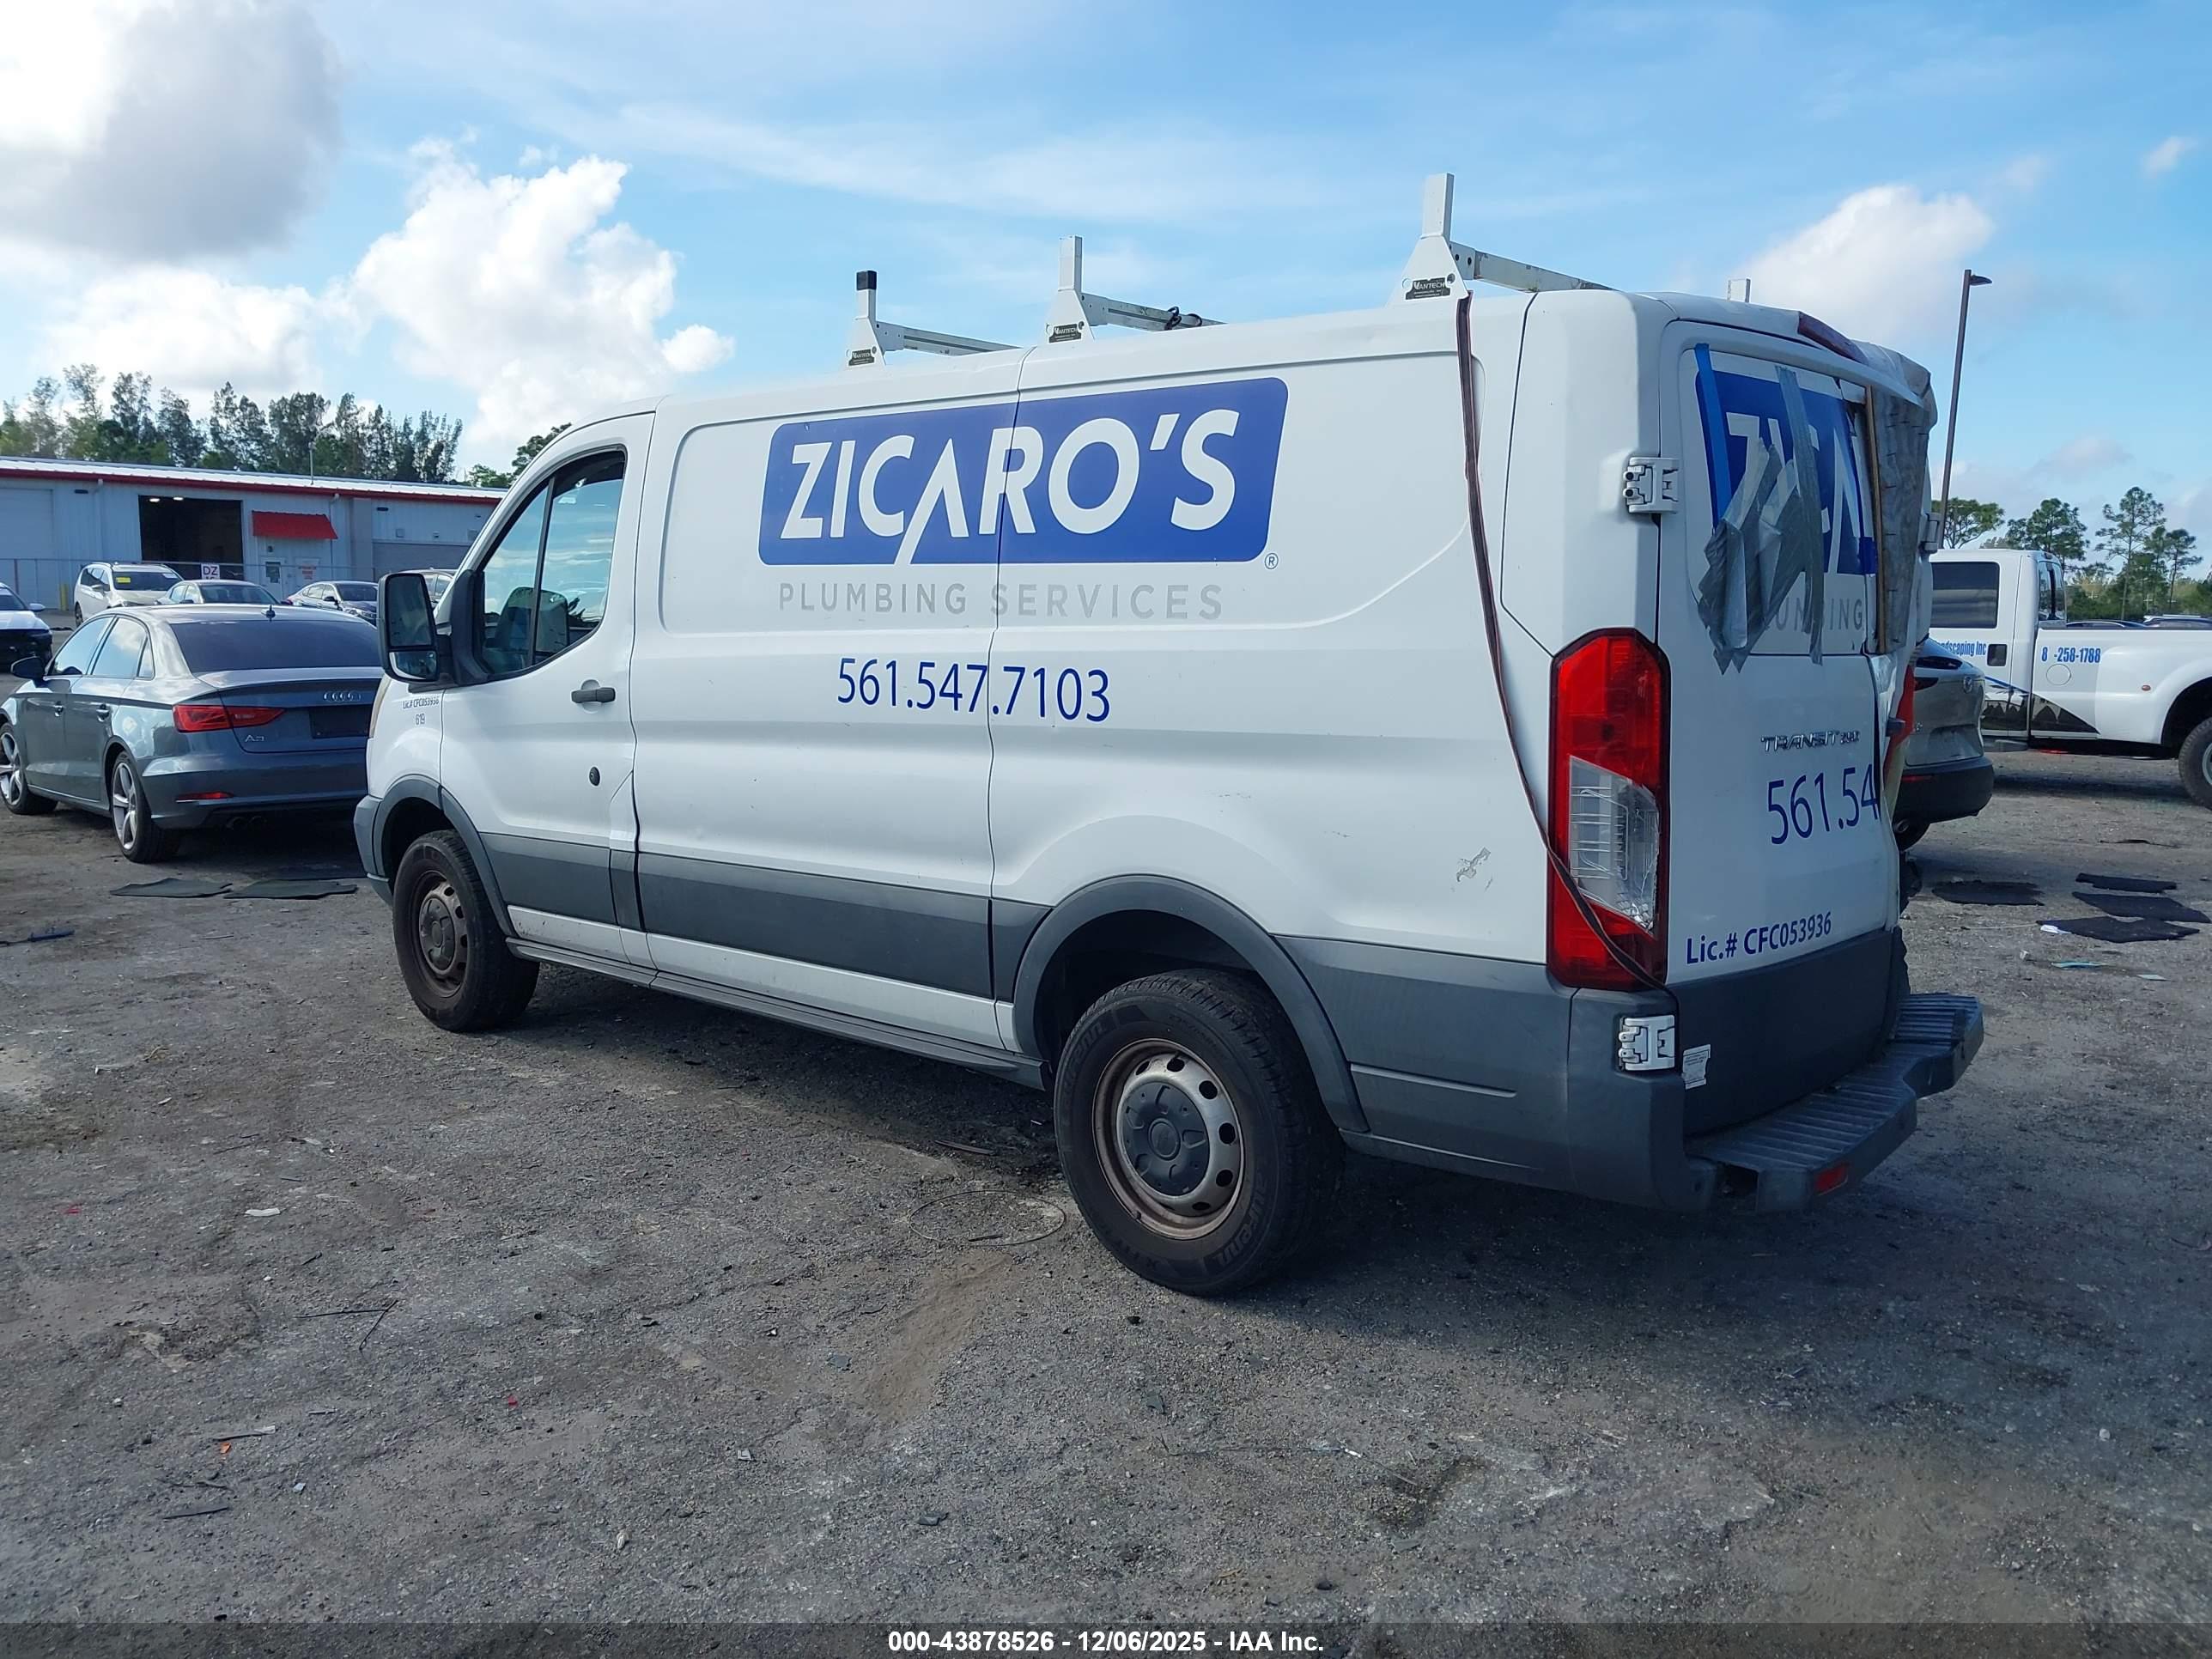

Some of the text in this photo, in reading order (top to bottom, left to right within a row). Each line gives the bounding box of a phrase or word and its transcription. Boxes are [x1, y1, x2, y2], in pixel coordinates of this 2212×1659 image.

[780, 409, 1240, 566] ZICARO'S
[203, 566, 218, 575] DZ
[779, 583, 1224, 621] PLUMBING SERVICES
[1976, 641, 1986, 656] Inc
[837, 658, 1110, 722] 561.547.7103
[1760, 731, 1839, 751] TRANSIT
[1767, 763, 1879, 845] 561.54
[1686, 911, 1832, 964] Lic.# CFC053936
